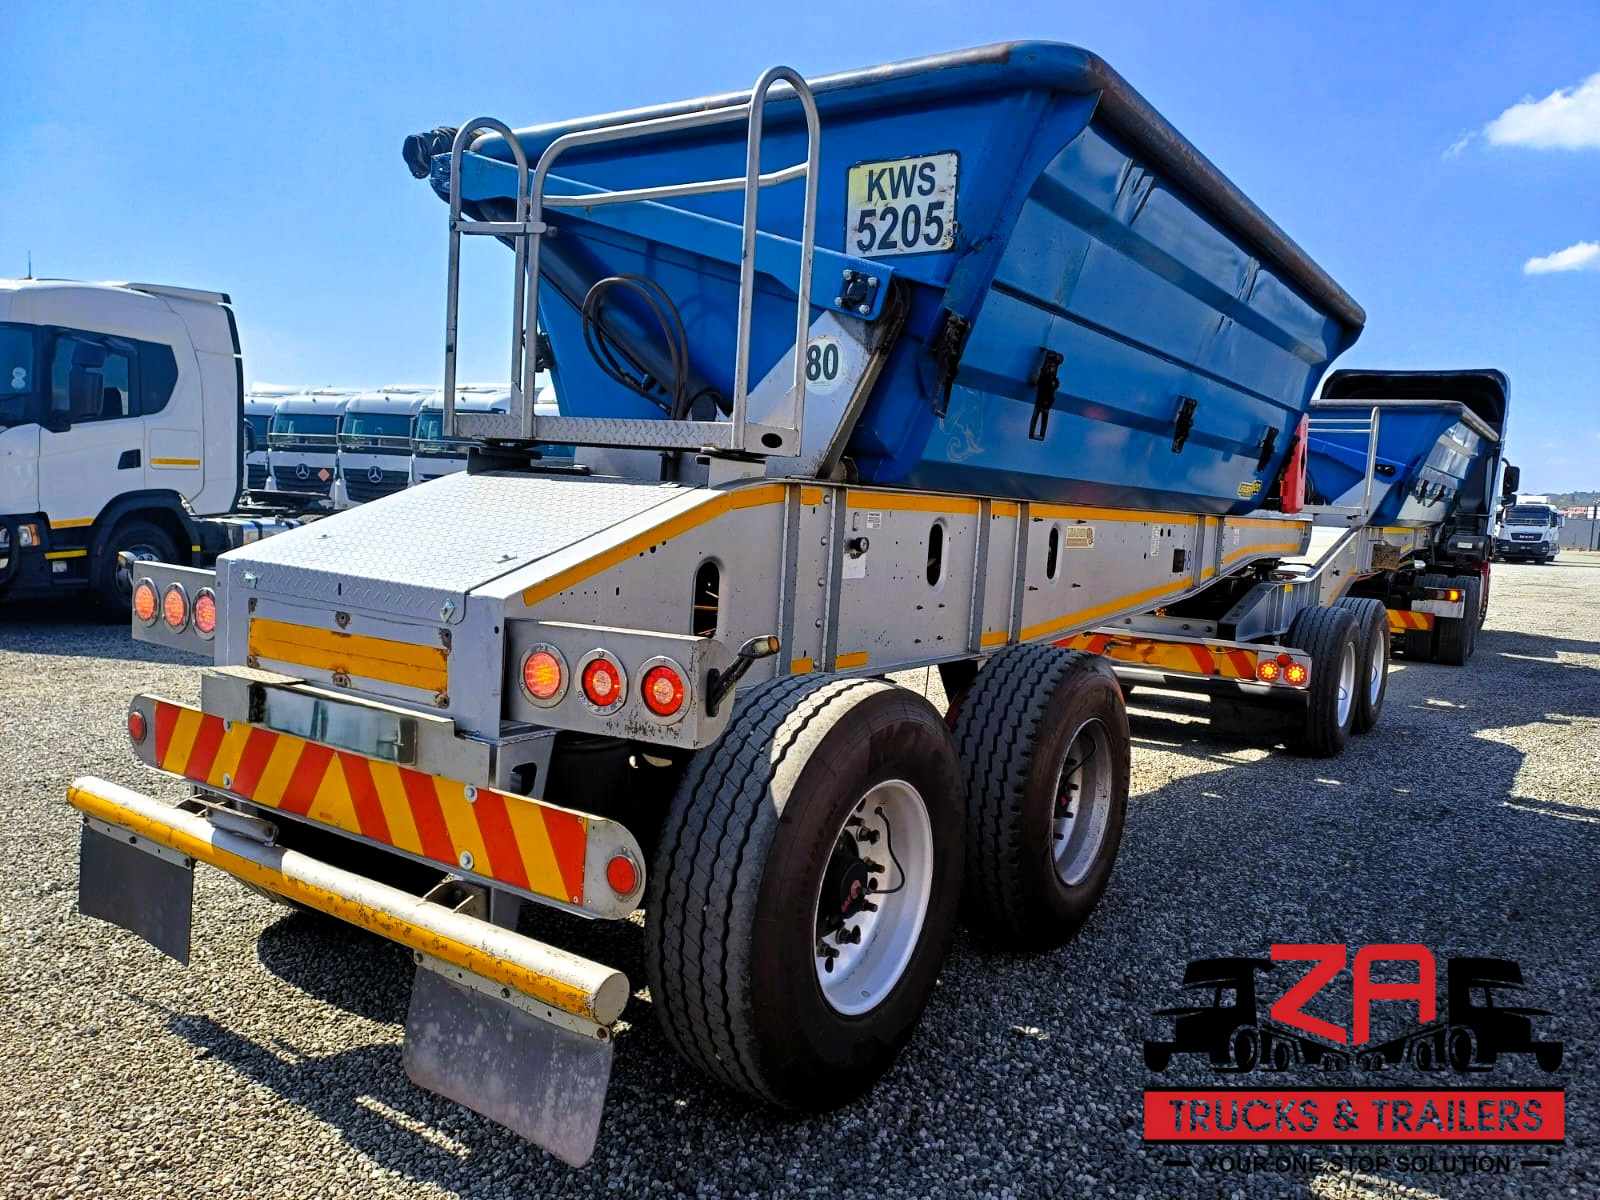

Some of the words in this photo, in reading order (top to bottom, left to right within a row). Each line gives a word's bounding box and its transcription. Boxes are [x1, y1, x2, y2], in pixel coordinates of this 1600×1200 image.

[867, 162, 936, 201] KWS
[856, 201, 945, 252] 5205
[806, 343, 839, 381] 80
